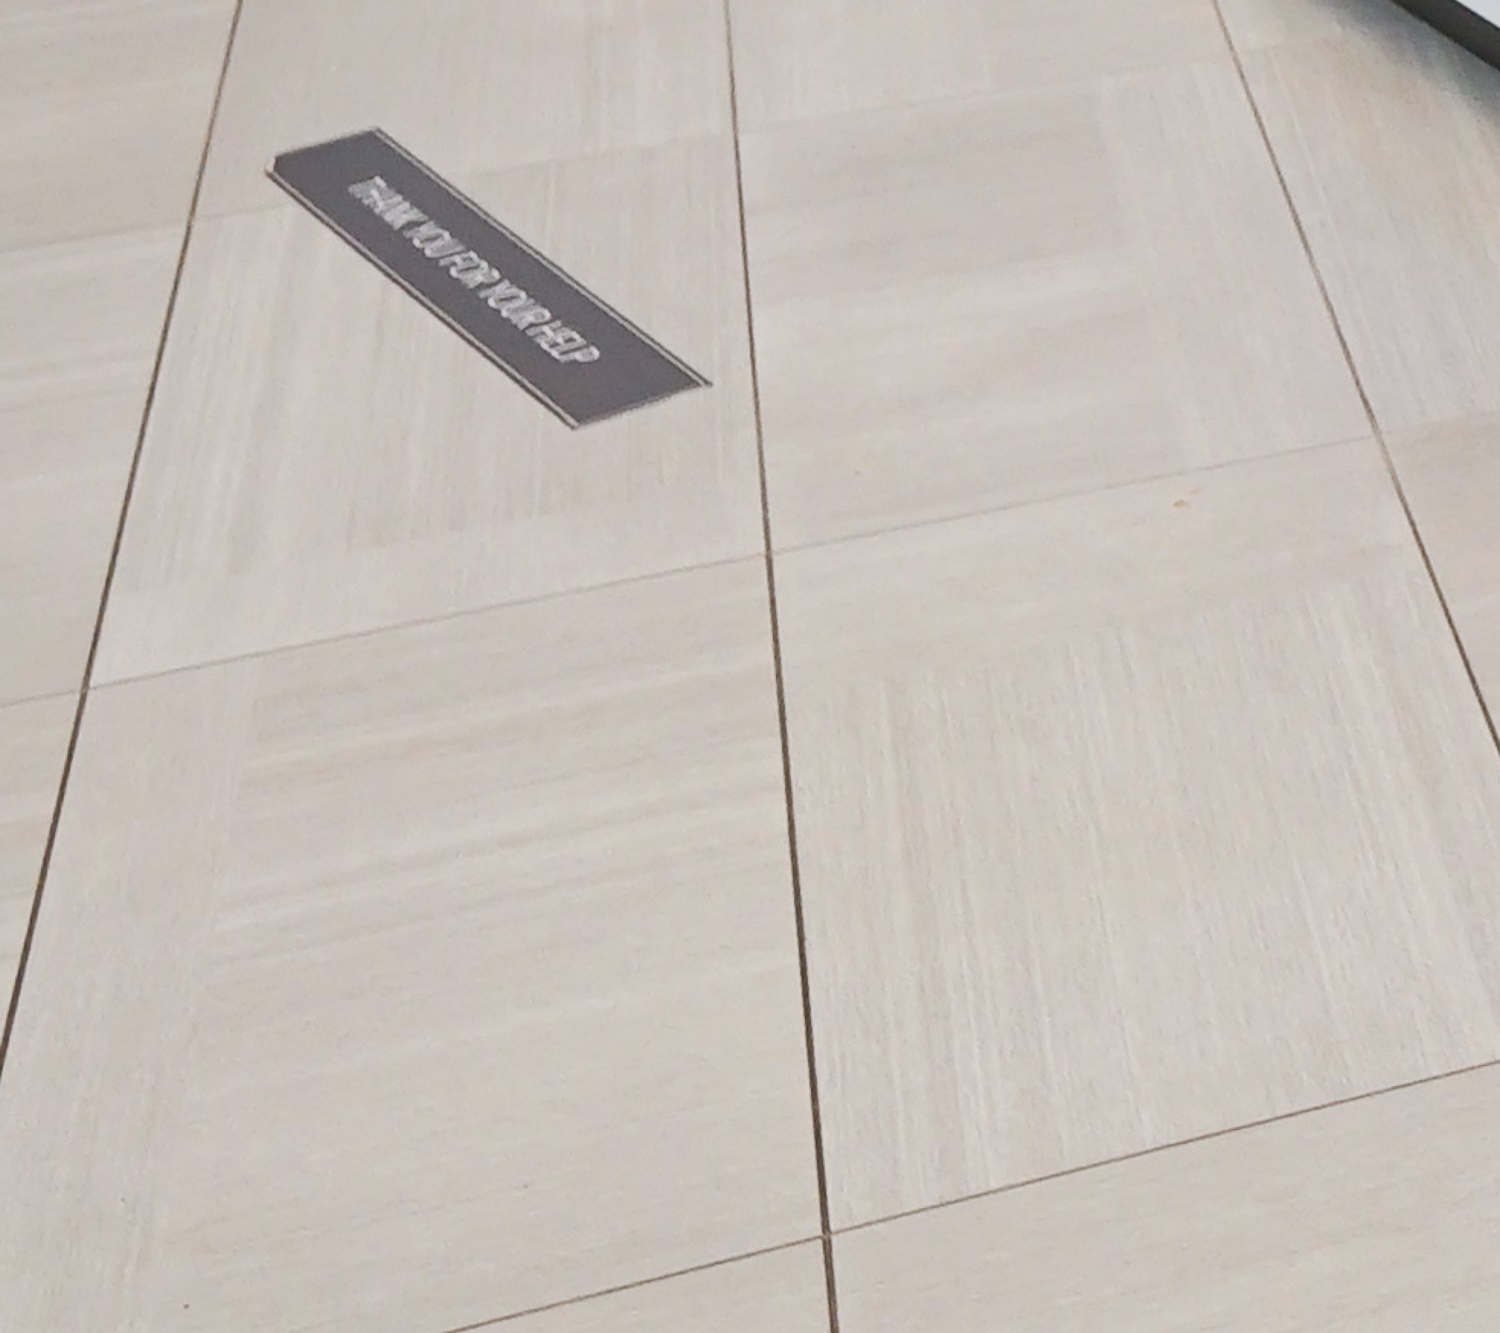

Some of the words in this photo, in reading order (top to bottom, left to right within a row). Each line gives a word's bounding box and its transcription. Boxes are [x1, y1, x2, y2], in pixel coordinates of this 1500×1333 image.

[347, 175, 428, 231] THANK
[403, 220, 467, 259] YOU
[438, 250, 502, 289] FOR
[479, 278, 553, 331] YOUR
[525, 319, 601, 364] HELP
